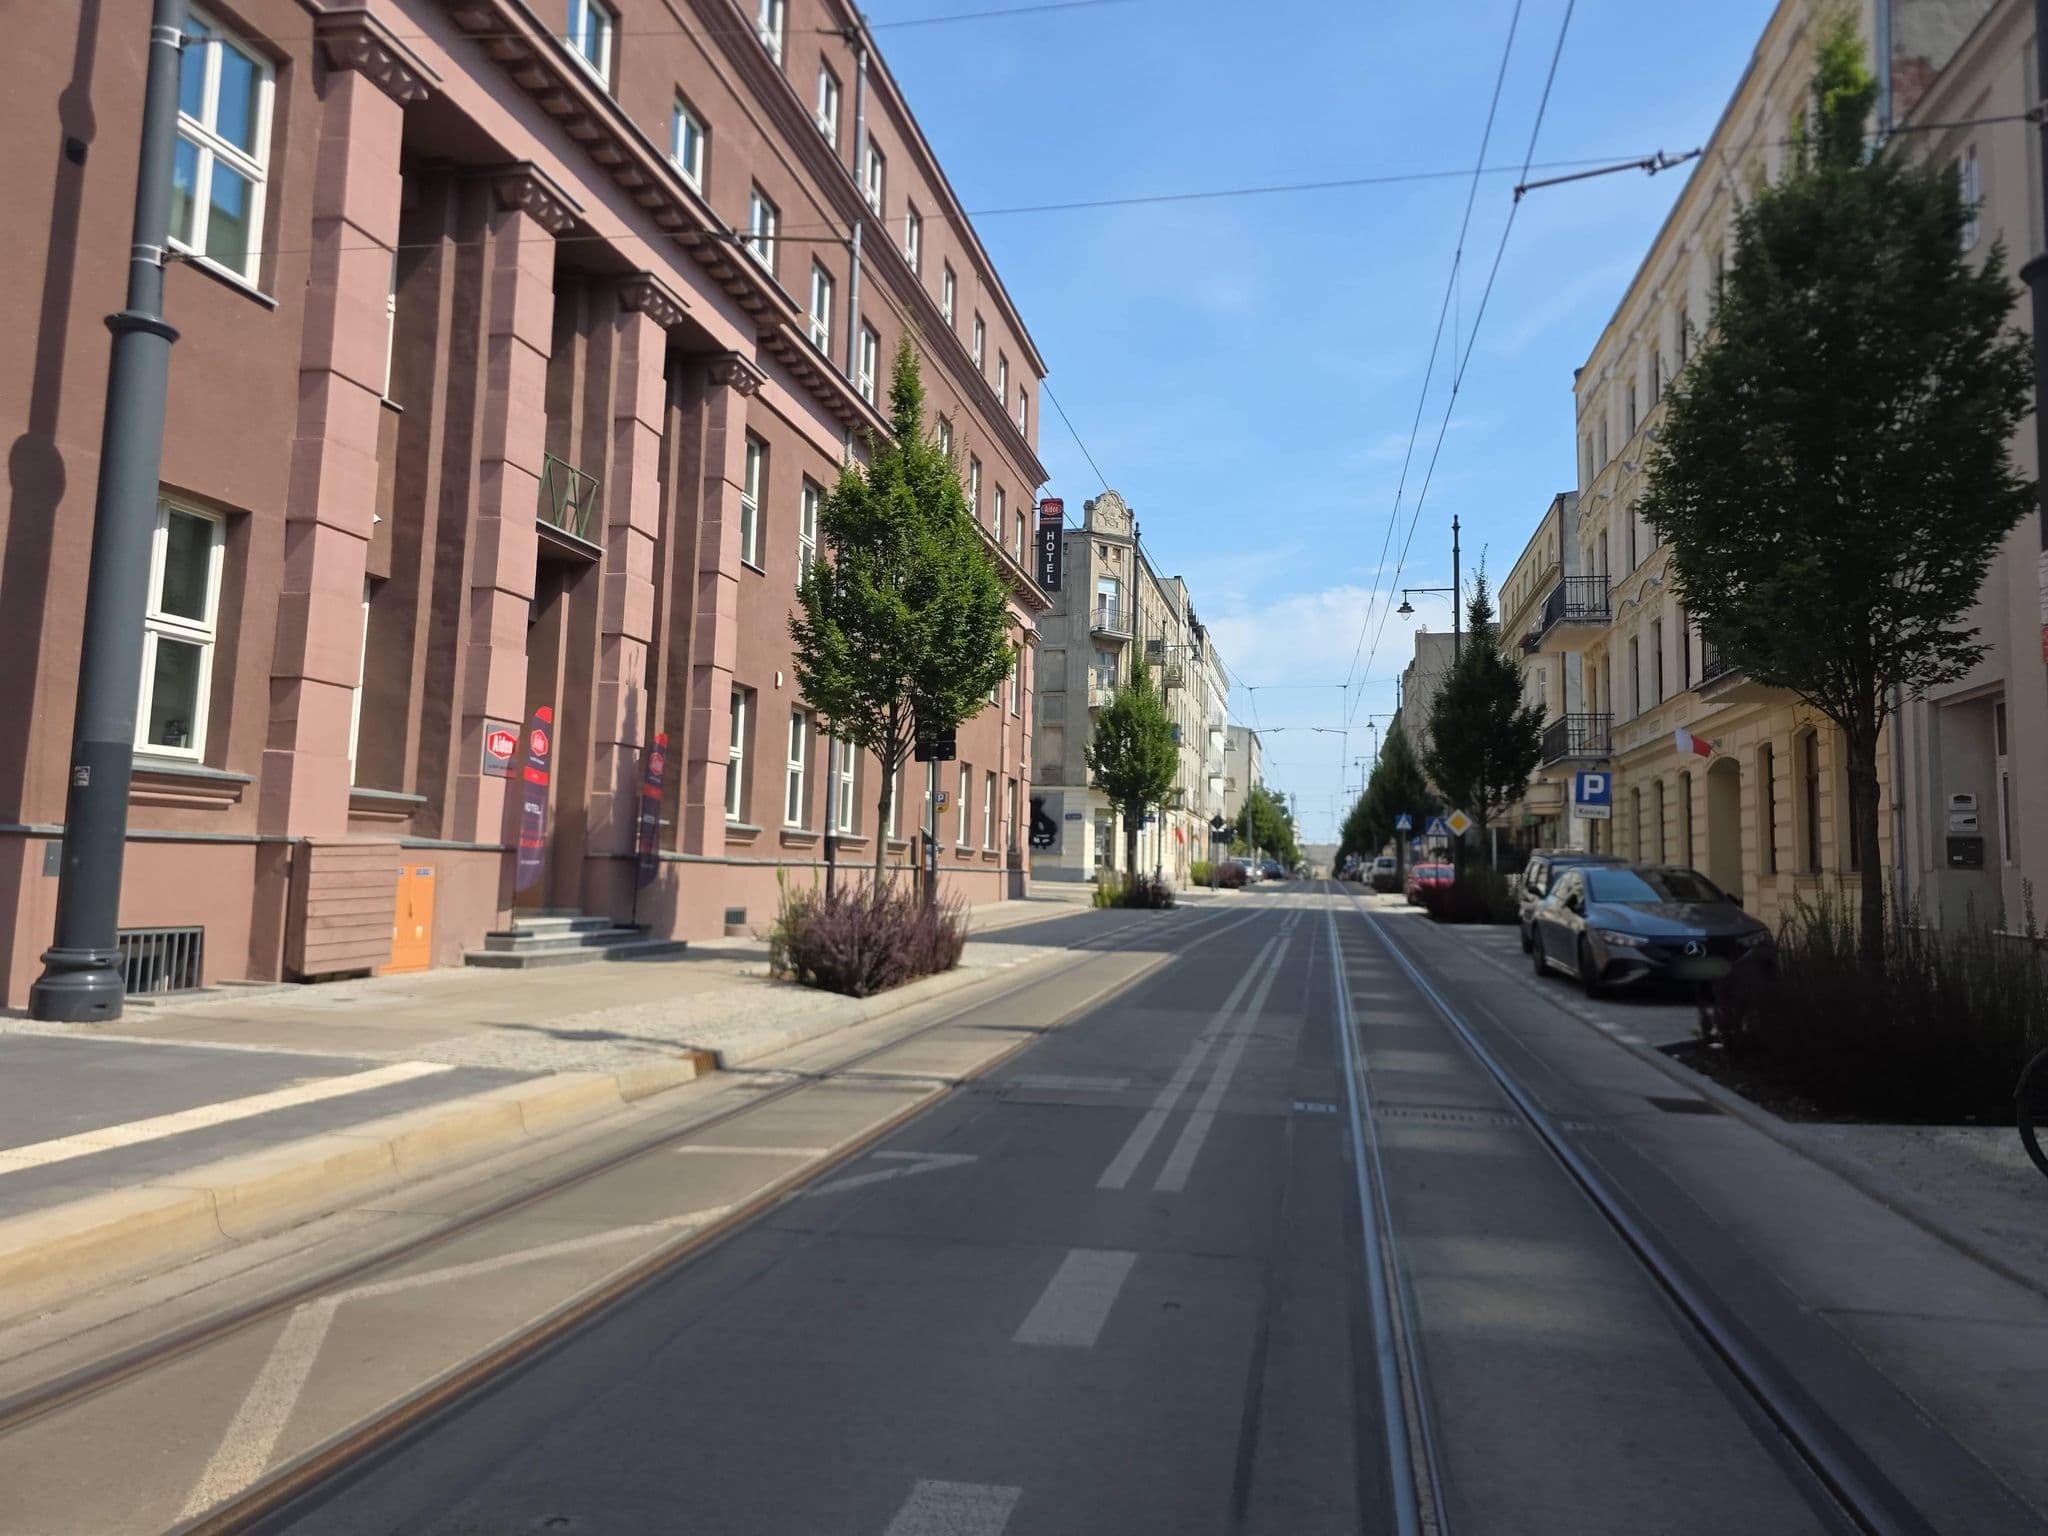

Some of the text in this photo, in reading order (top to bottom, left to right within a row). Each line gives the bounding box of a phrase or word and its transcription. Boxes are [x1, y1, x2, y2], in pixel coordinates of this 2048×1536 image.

[1046, 531, 1055, 583] HOTEL
[492, 735, 513, 753] Aiden
[1583, 775, 1604, 800] P
[524, 802, 541, 814] HOTEL
